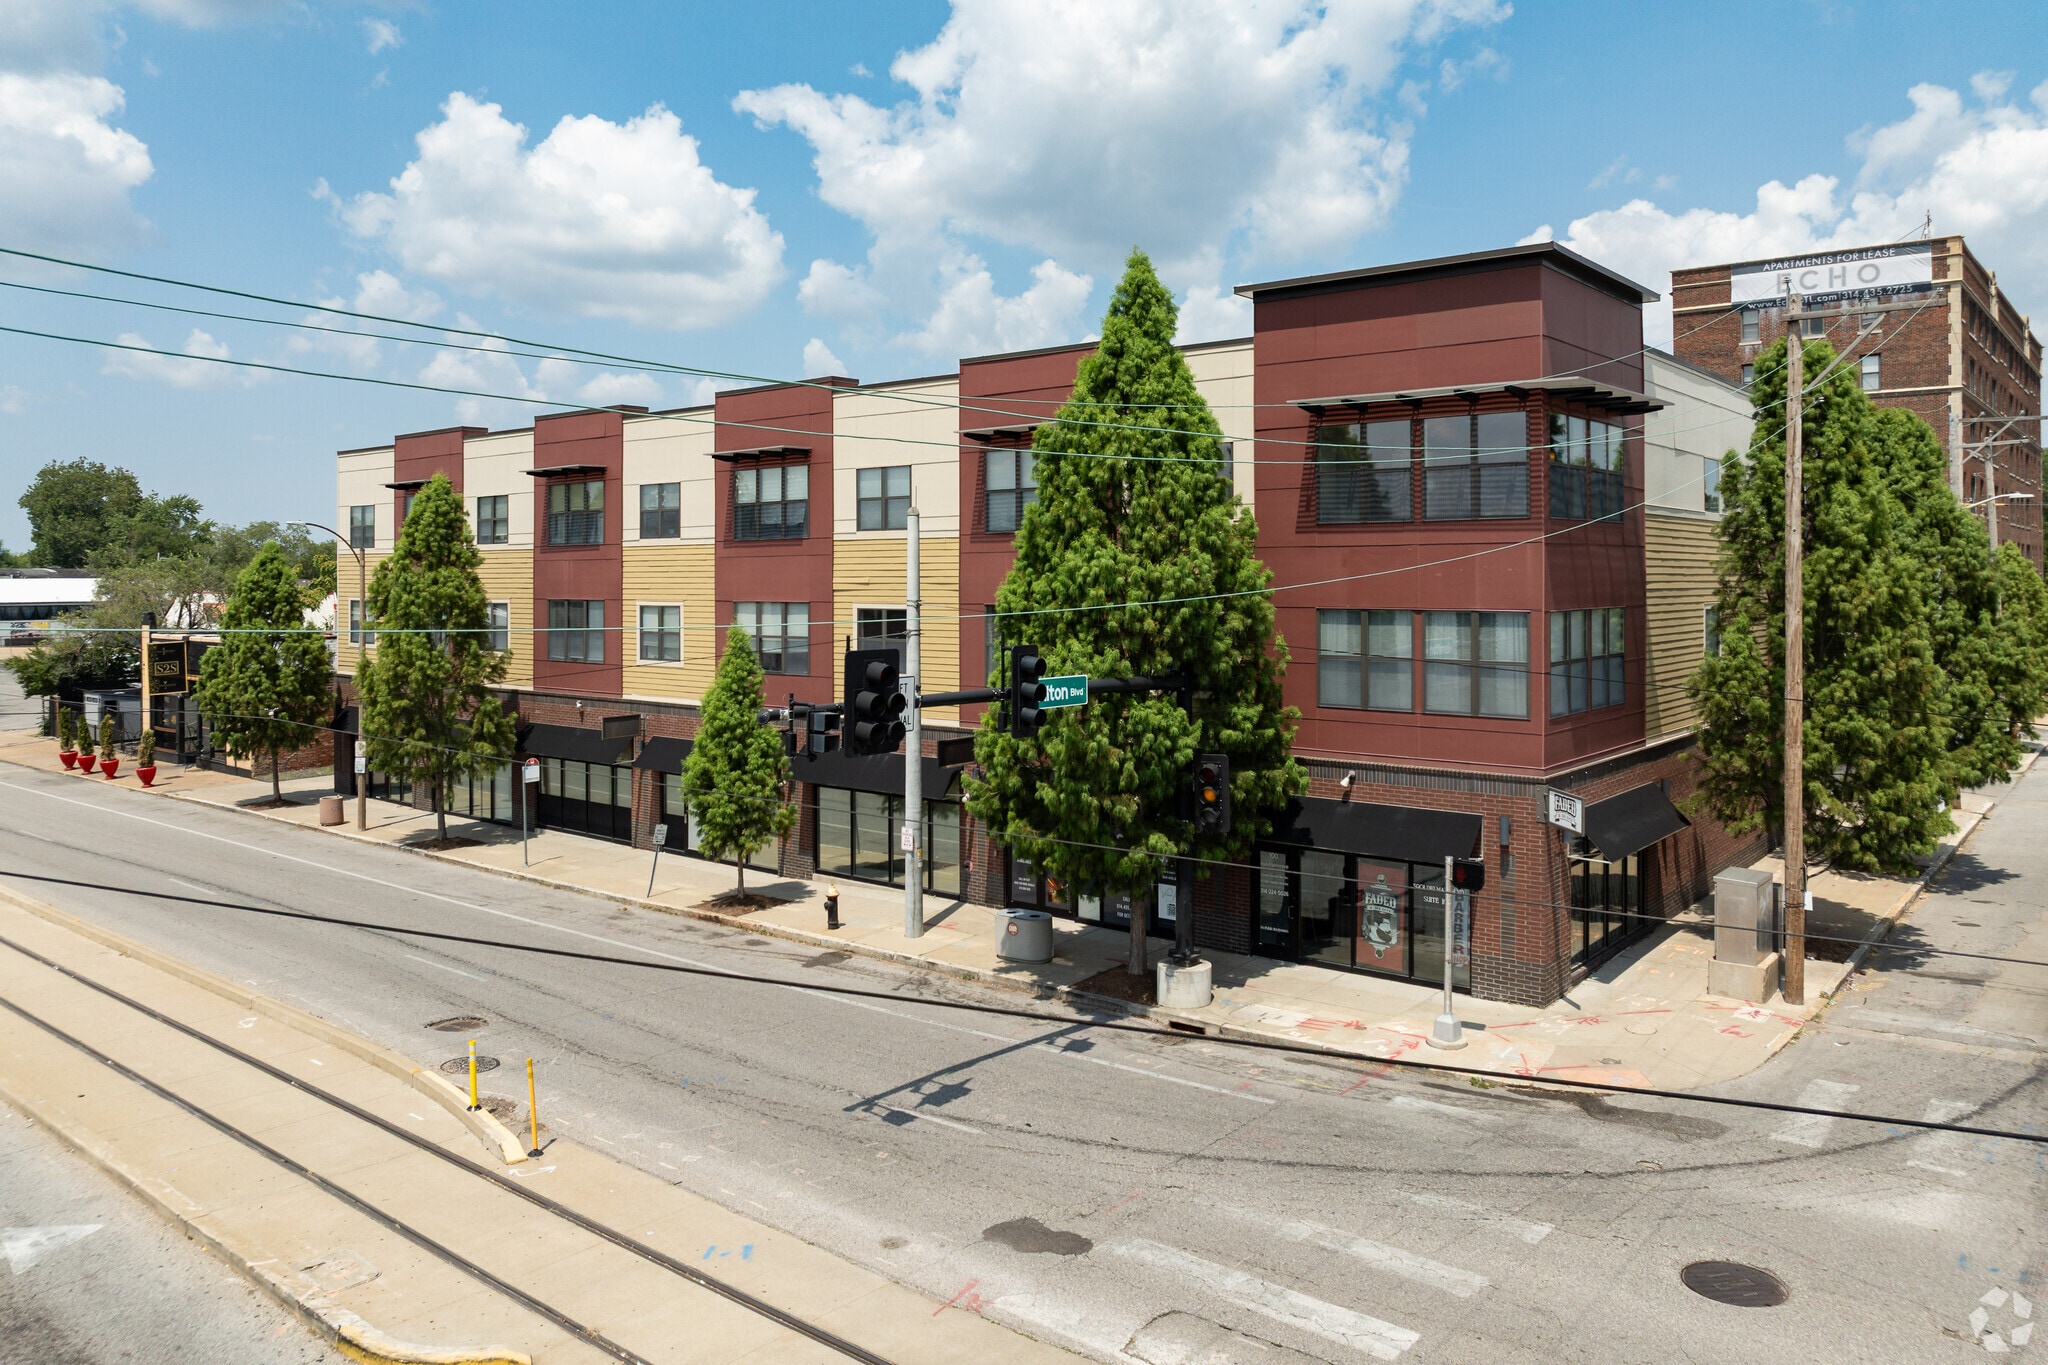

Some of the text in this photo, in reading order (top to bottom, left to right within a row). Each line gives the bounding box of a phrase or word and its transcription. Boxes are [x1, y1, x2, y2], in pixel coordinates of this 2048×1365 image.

[1762, 247, 1896, 272] APARTMENTS FOR LEASE
[1776, 263, 1881, 294] ECHO
[157, 663, 177, 674] S2S
[1044, 684, 1084, 701] lton Blvd
[1364, 891, 1397, 909] FADED
[1423, 895, 1440, 904] SUITE
